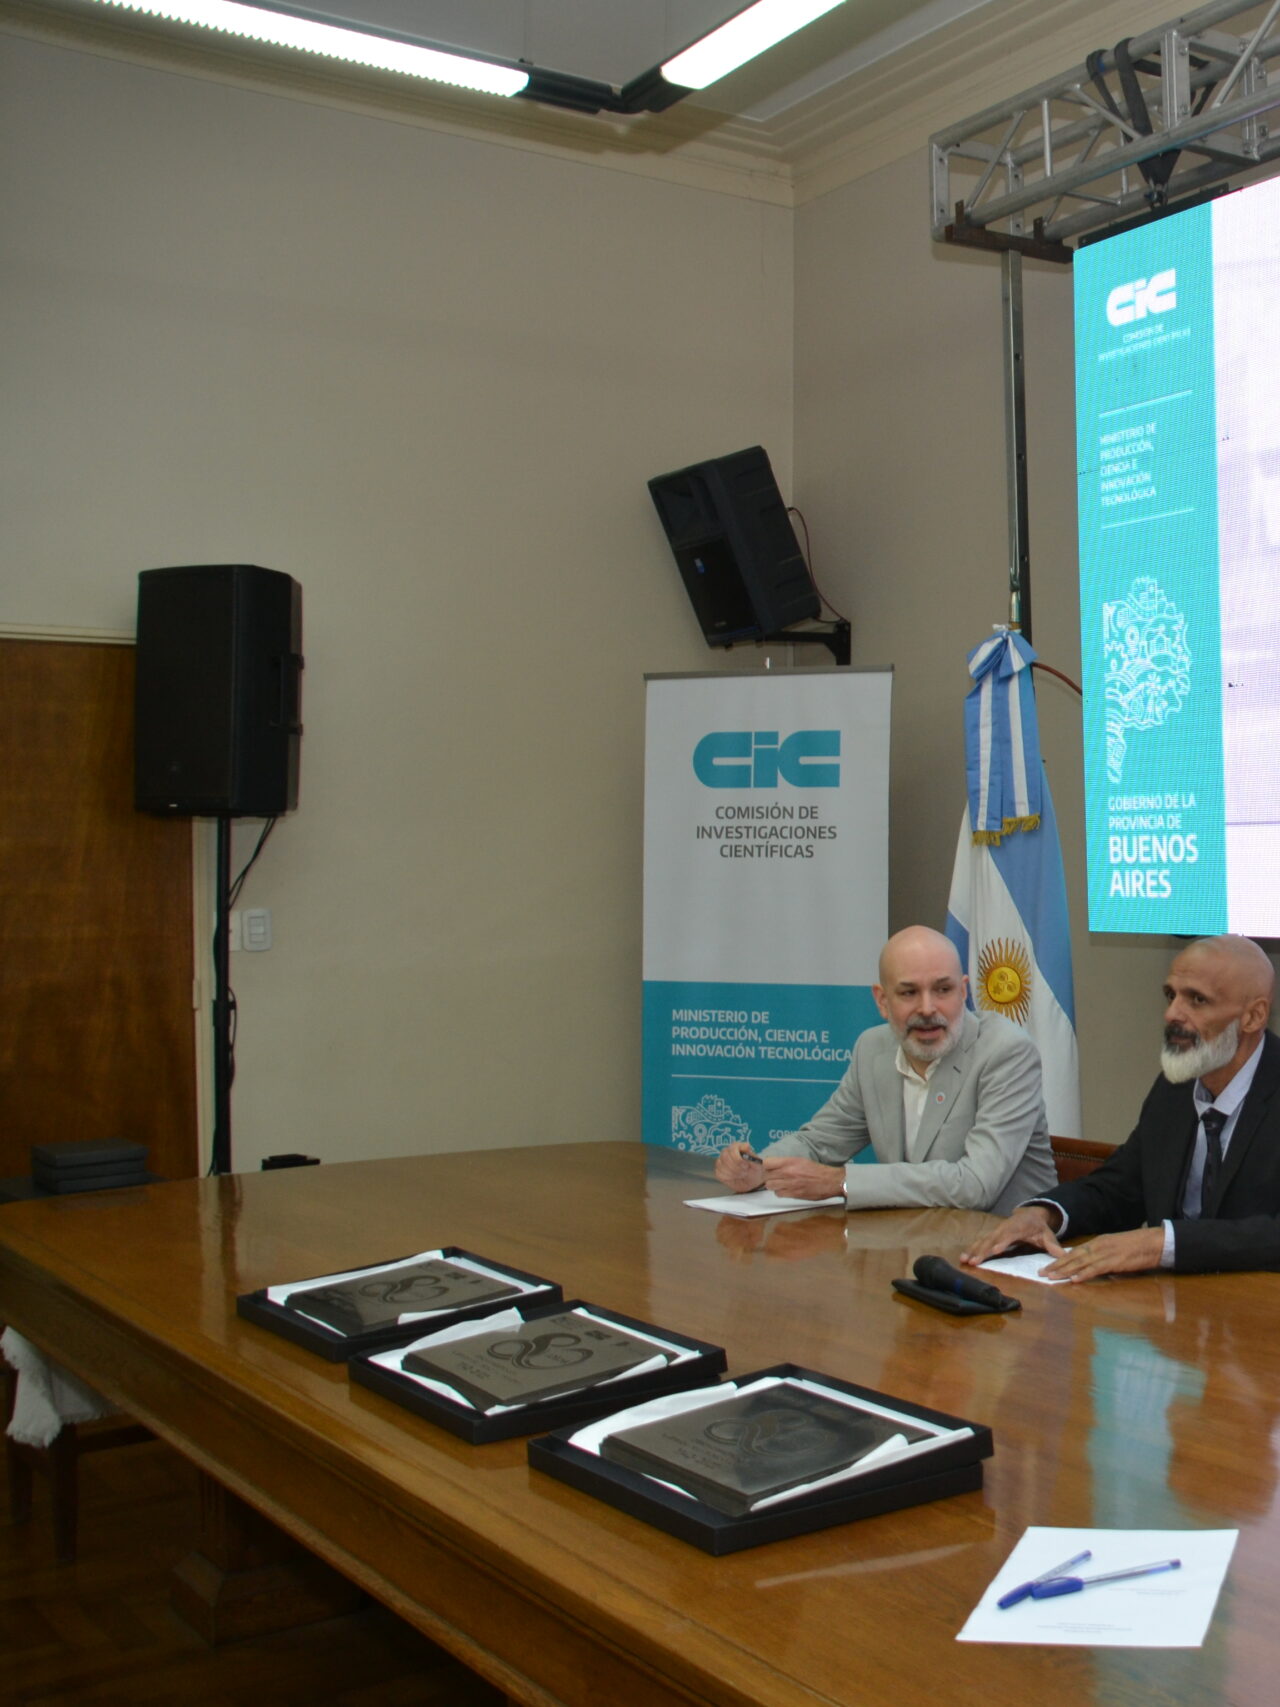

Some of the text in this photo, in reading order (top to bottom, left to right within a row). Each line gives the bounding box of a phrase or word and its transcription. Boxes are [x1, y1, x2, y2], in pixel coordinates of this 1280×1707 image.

[1108, 792, 1196, 811] GOBIERNO DE LA
[715, 802, 819, 820] COMISIÓN DE
[1108, 814, 1182, 830] PROVINCIA DE
[696, 825, 837, 840] INVESTIGACIONES
[719, 841, 814, 859] CIENTÍFICAS
[1109, 834, 1199, 863] BUENOS
[1109, 868, 1172, 898] AIRES
[672, 1009, 770, 1024] MINISTERIO DE
[672, 1024, 829, 1044] PRODUCCIÓN, CIENCIA E
[672, 1042, 853, 1062] INNOVACIÓN TECNOLÓGICA
